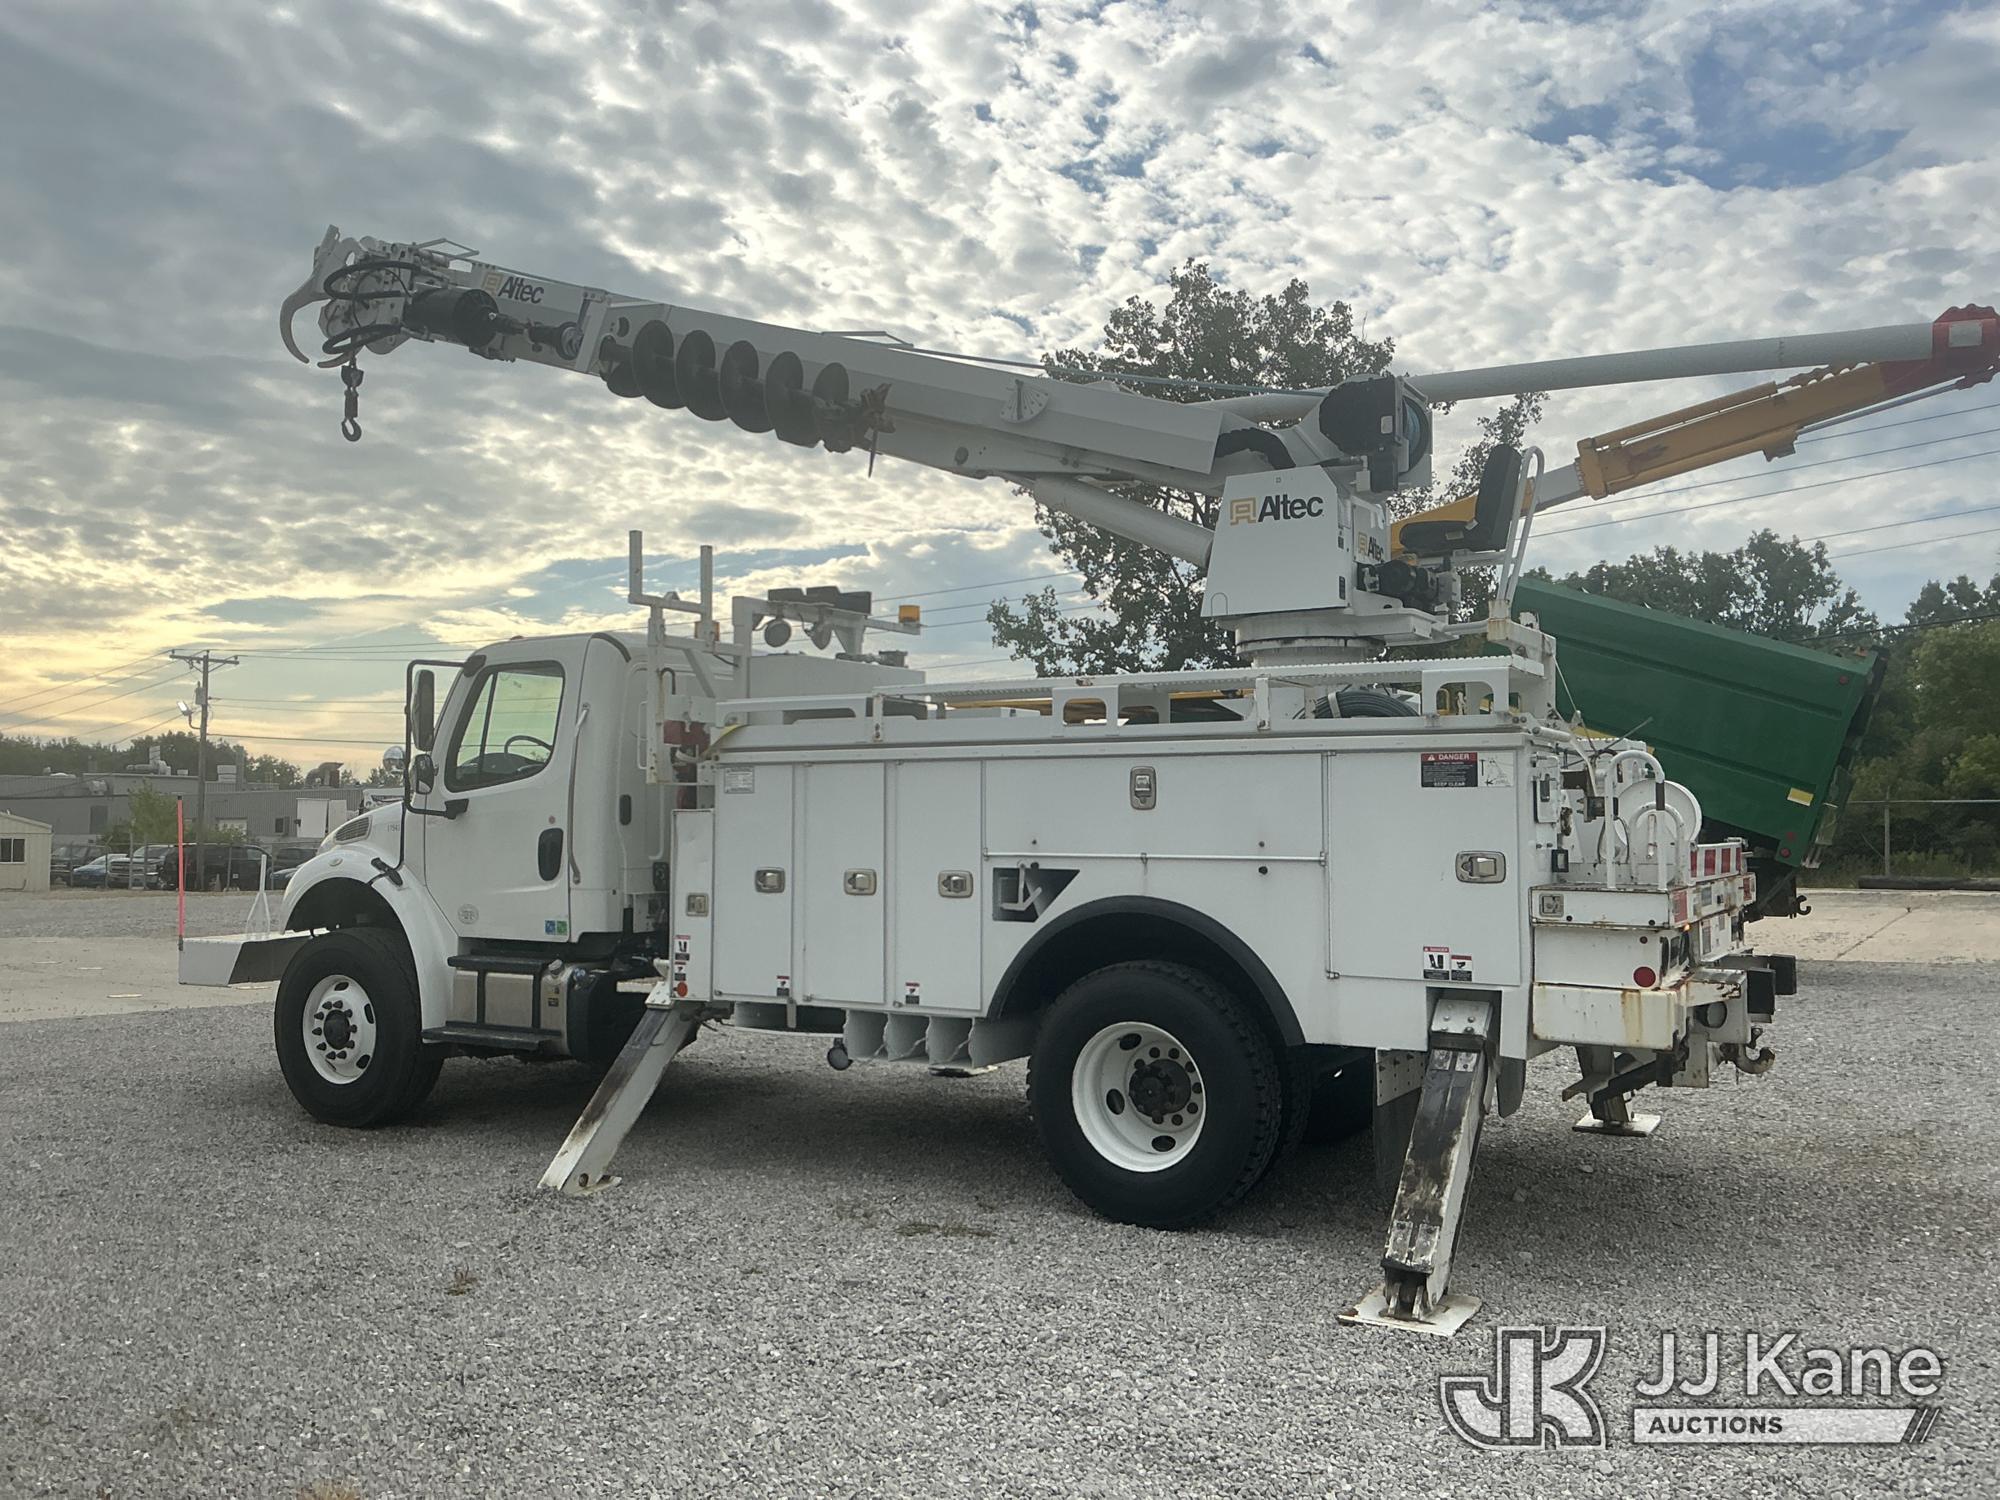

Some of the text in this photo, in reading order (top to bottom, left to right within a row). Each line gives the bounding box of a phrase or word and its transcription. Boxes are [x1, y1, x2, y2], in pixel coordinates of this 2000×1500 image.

[498, 276, 544, 304] Altec
[1258, 494, 1324, 523] Altec
[1438, 753, 1470, 761] DANGER
